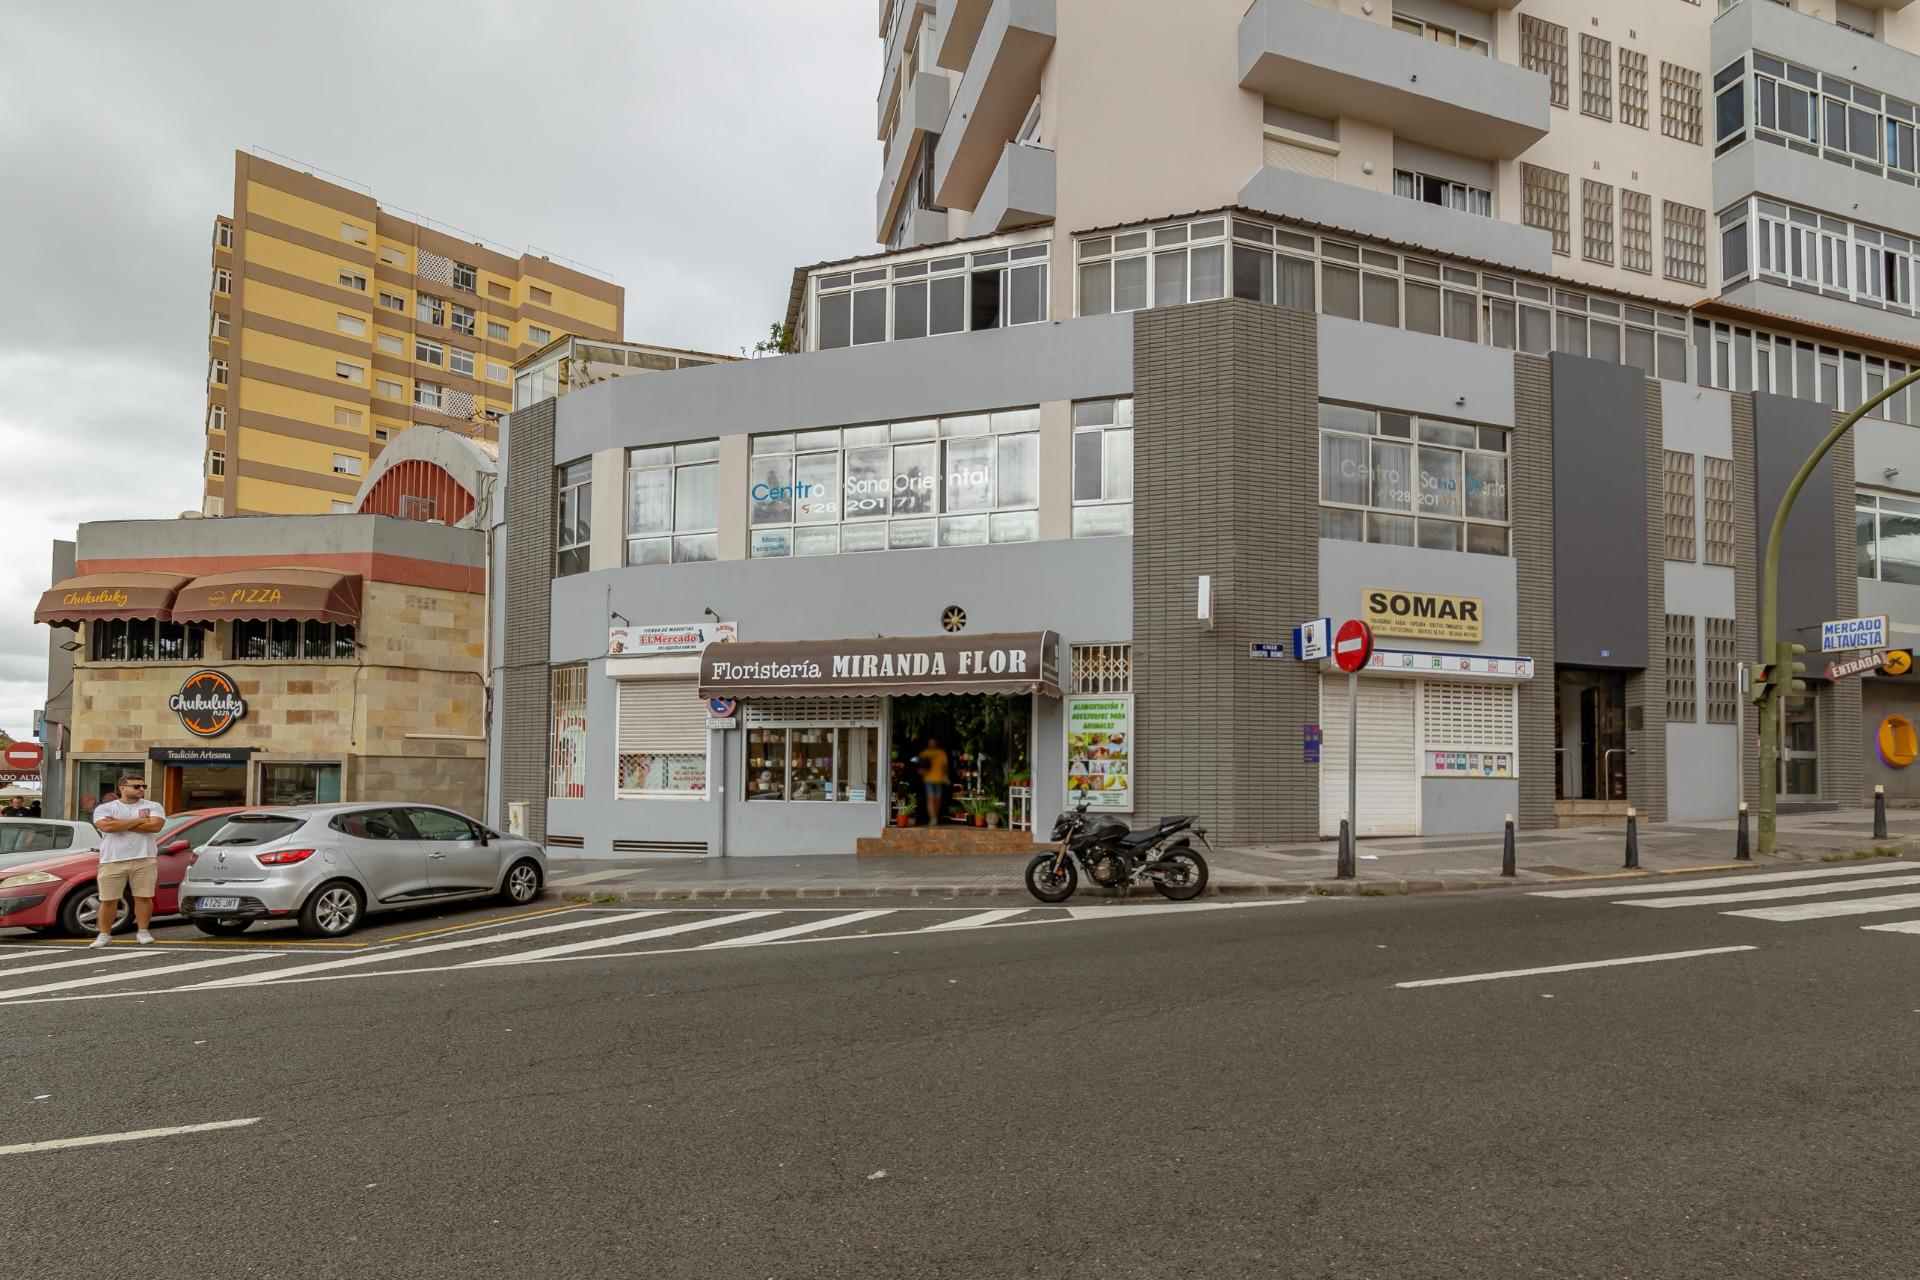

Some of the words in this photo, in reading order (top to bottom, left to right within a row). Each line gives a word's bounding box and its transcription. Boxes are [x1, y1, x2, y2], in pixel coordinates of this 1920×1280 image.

[751, 480, 825, 501] Centro
[847, 475, 889, 494] Sana
[1421, 471, 1456, 491] Sana
[1465, 474, 1506, 497] Orienta
[846, 498, 884, 510] 201
[1418, 495, 1439, 506] 201
[63, 590, 129, 607] Chukuluky
[230, 588, 282, 605] PIZZA
[1369, 592, 1478, 621] SOMAR
[1824, 619, 1882, 635] MERCADO
[653, 634, 697, 644] Mercado
[1824, 631, 1882, 650] ALTAVISTA
[711, 659, 822, 680] Floristería
[832, 652, 947, 678] MIRANDA
[958, 650, 1027, 674] FLOR
[1831, 654, 1882, 678] ENTRADA
[170, 694, 242, 716] Chukuluky
[167, 750, 199, 759] Tradición
[200, 750, 231, 759] Artesana
